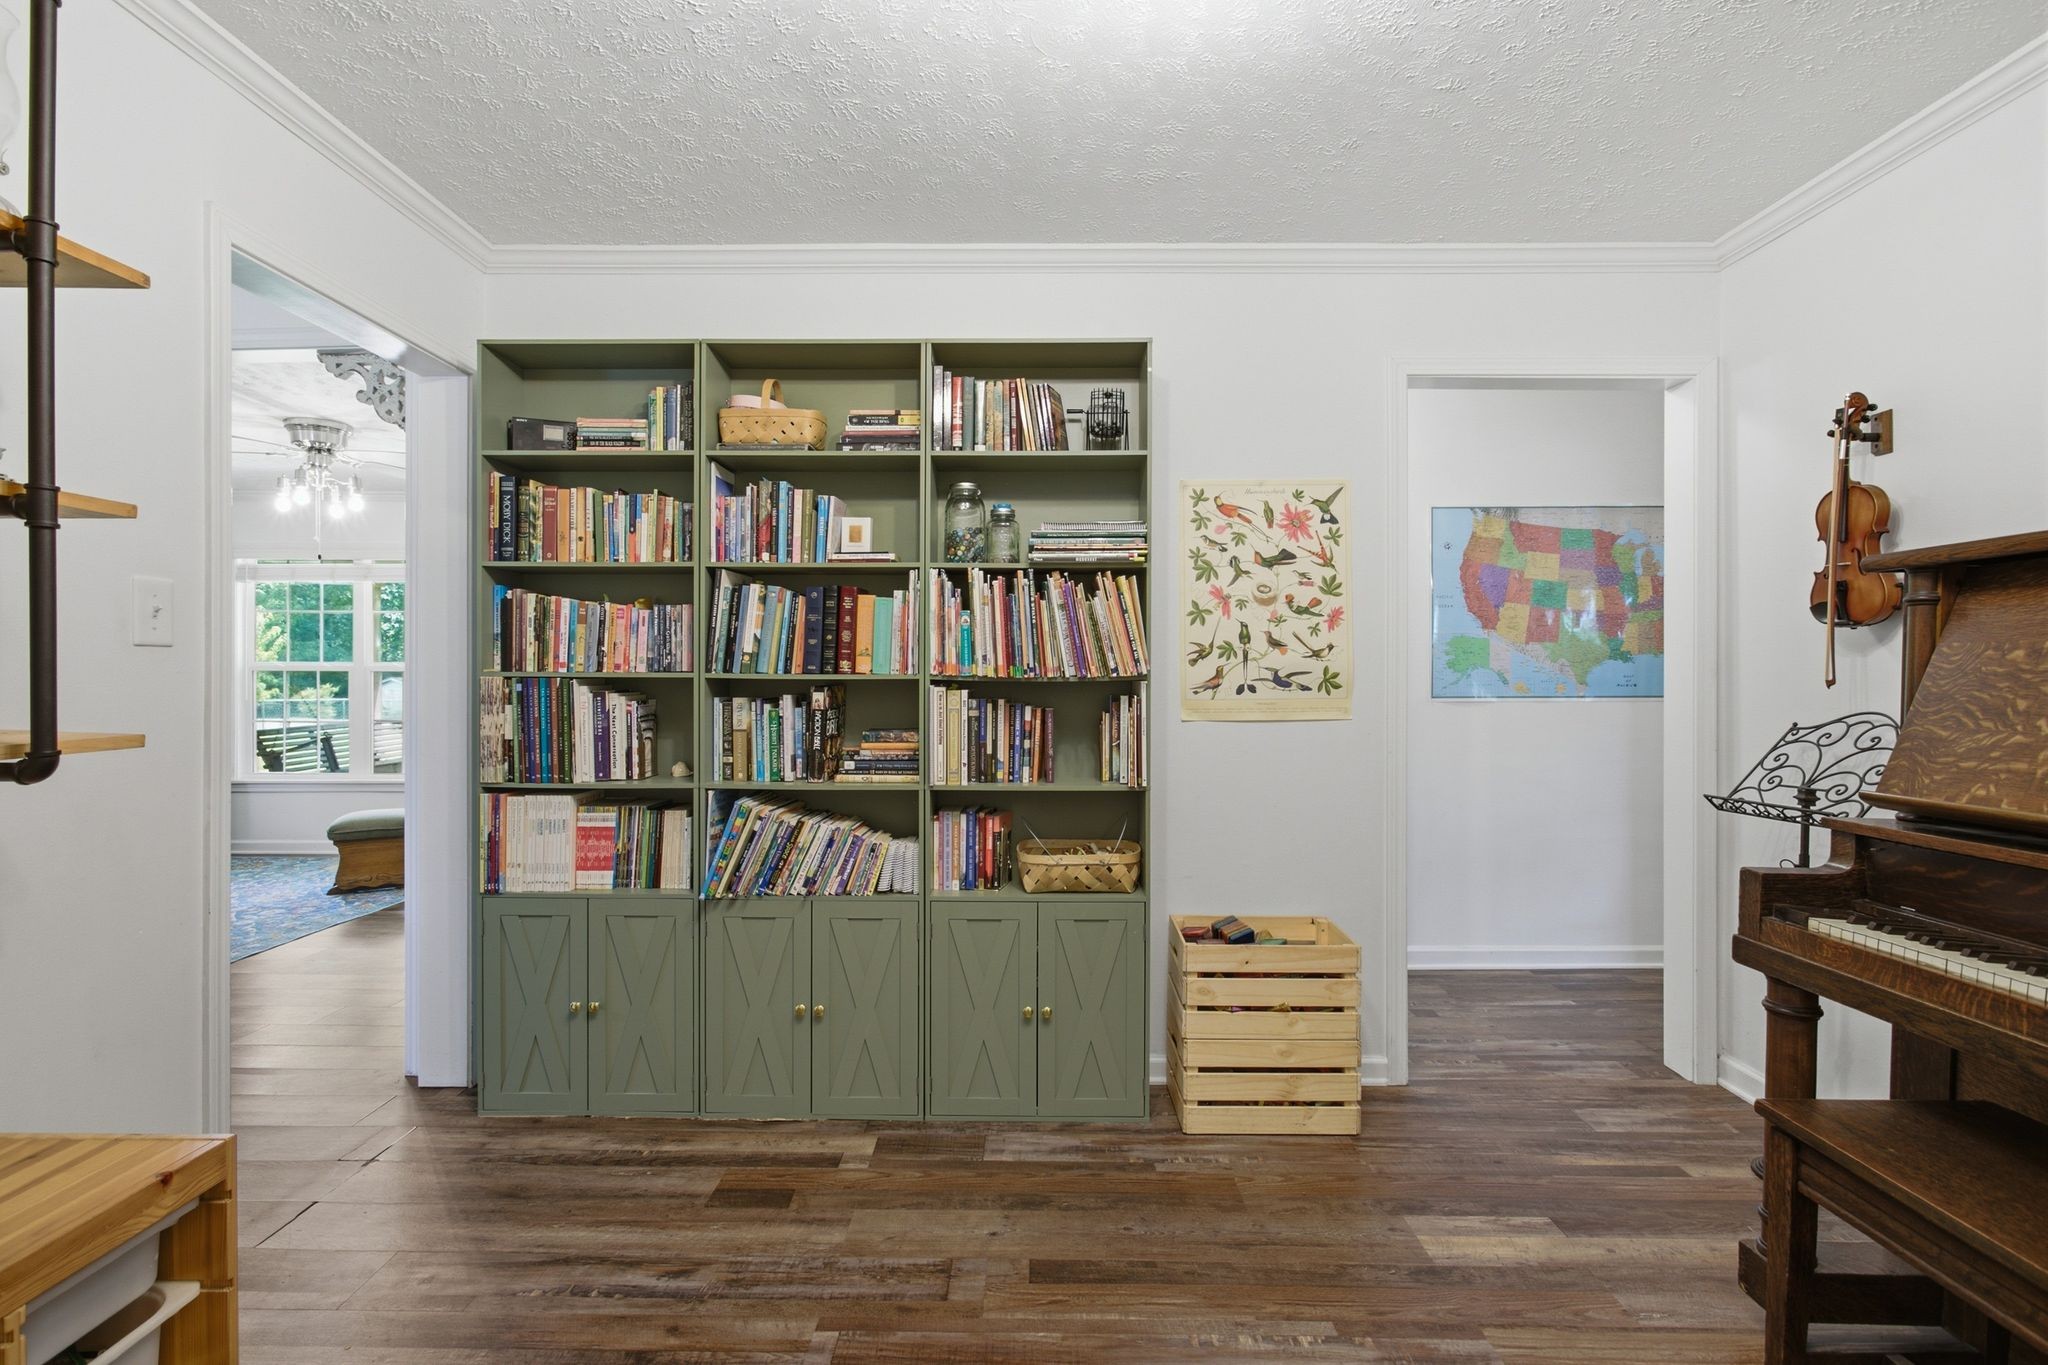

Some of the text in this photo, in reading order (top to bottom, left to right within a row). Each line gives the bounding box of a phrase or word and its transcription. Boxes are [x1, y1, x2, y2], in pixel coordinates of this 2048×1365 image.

[503, 495, 511, 543] MOBY DICK
[813, 711, 822, 736] ACTION
